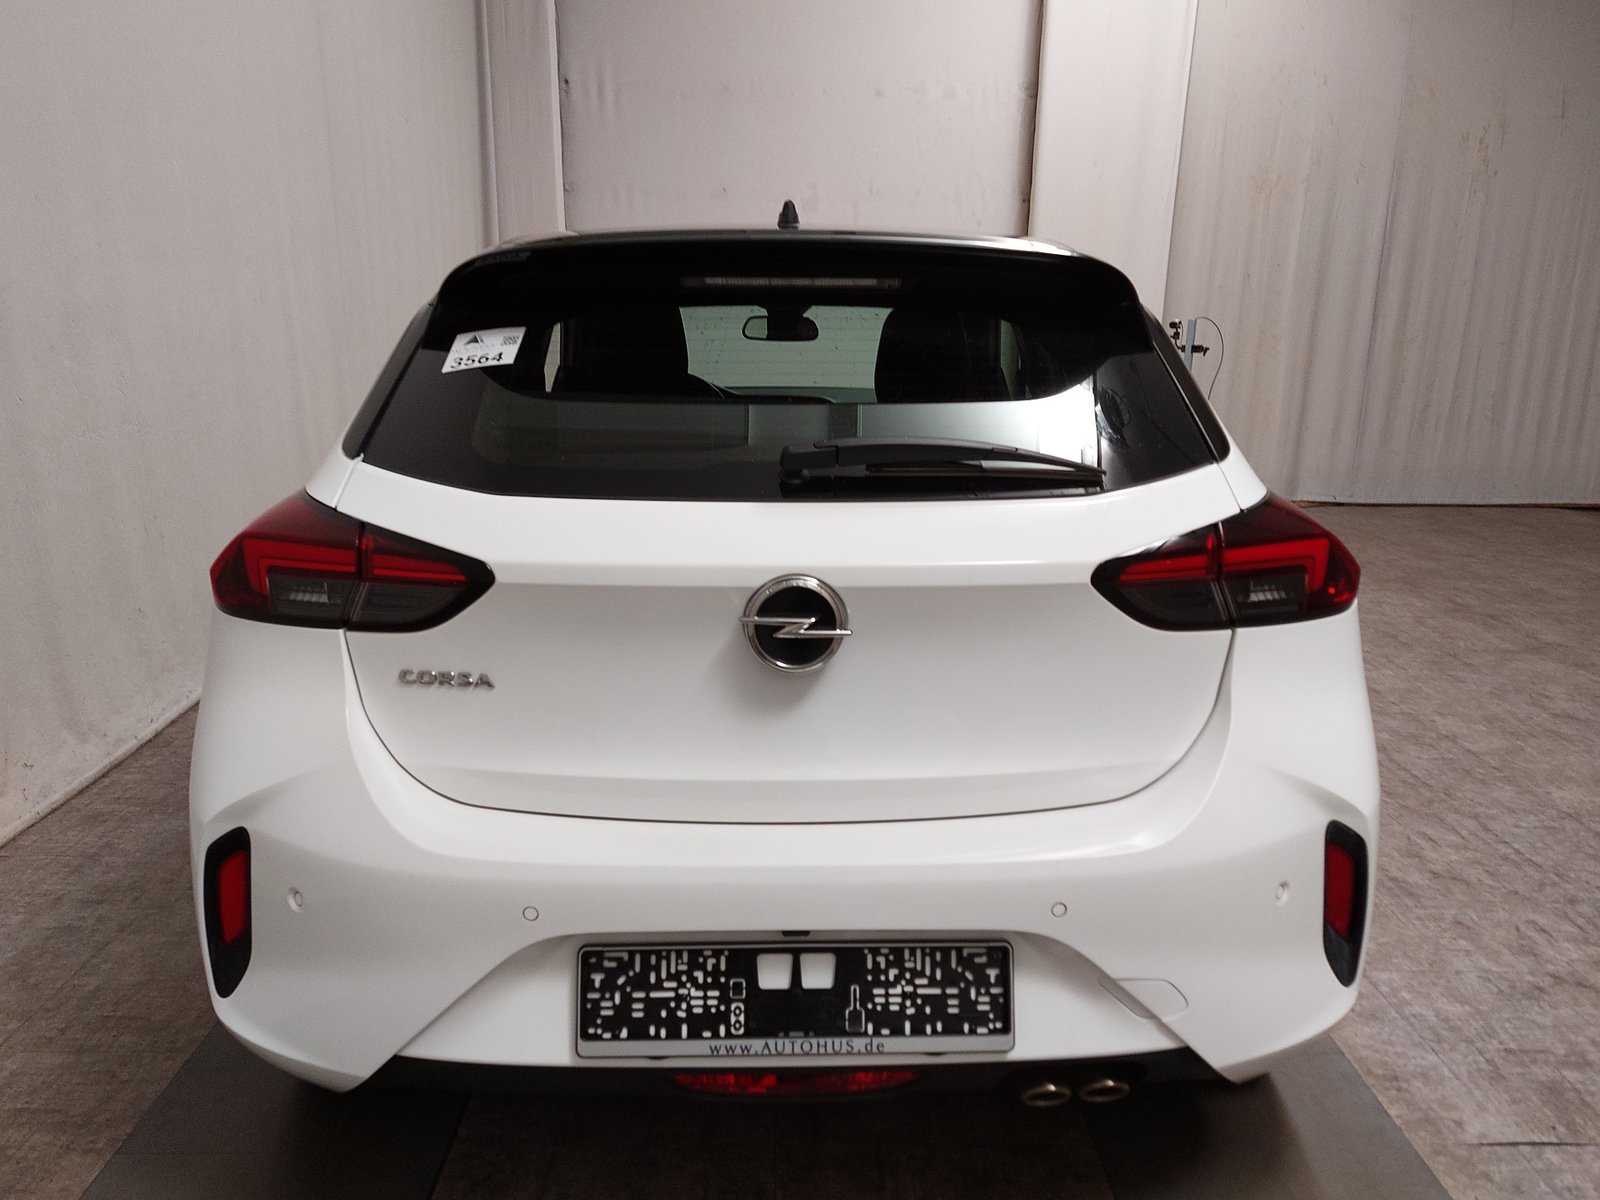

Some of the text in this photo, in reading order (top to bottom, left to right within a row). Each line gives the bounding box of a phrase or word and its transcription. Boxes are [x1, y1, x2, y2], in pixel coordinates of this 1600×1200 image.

[450, 352, 503, 368] 3564
[398, 669, 495, 688] CORSA
[709, 1038, 885, 1055] www.AUTOHUS.de
